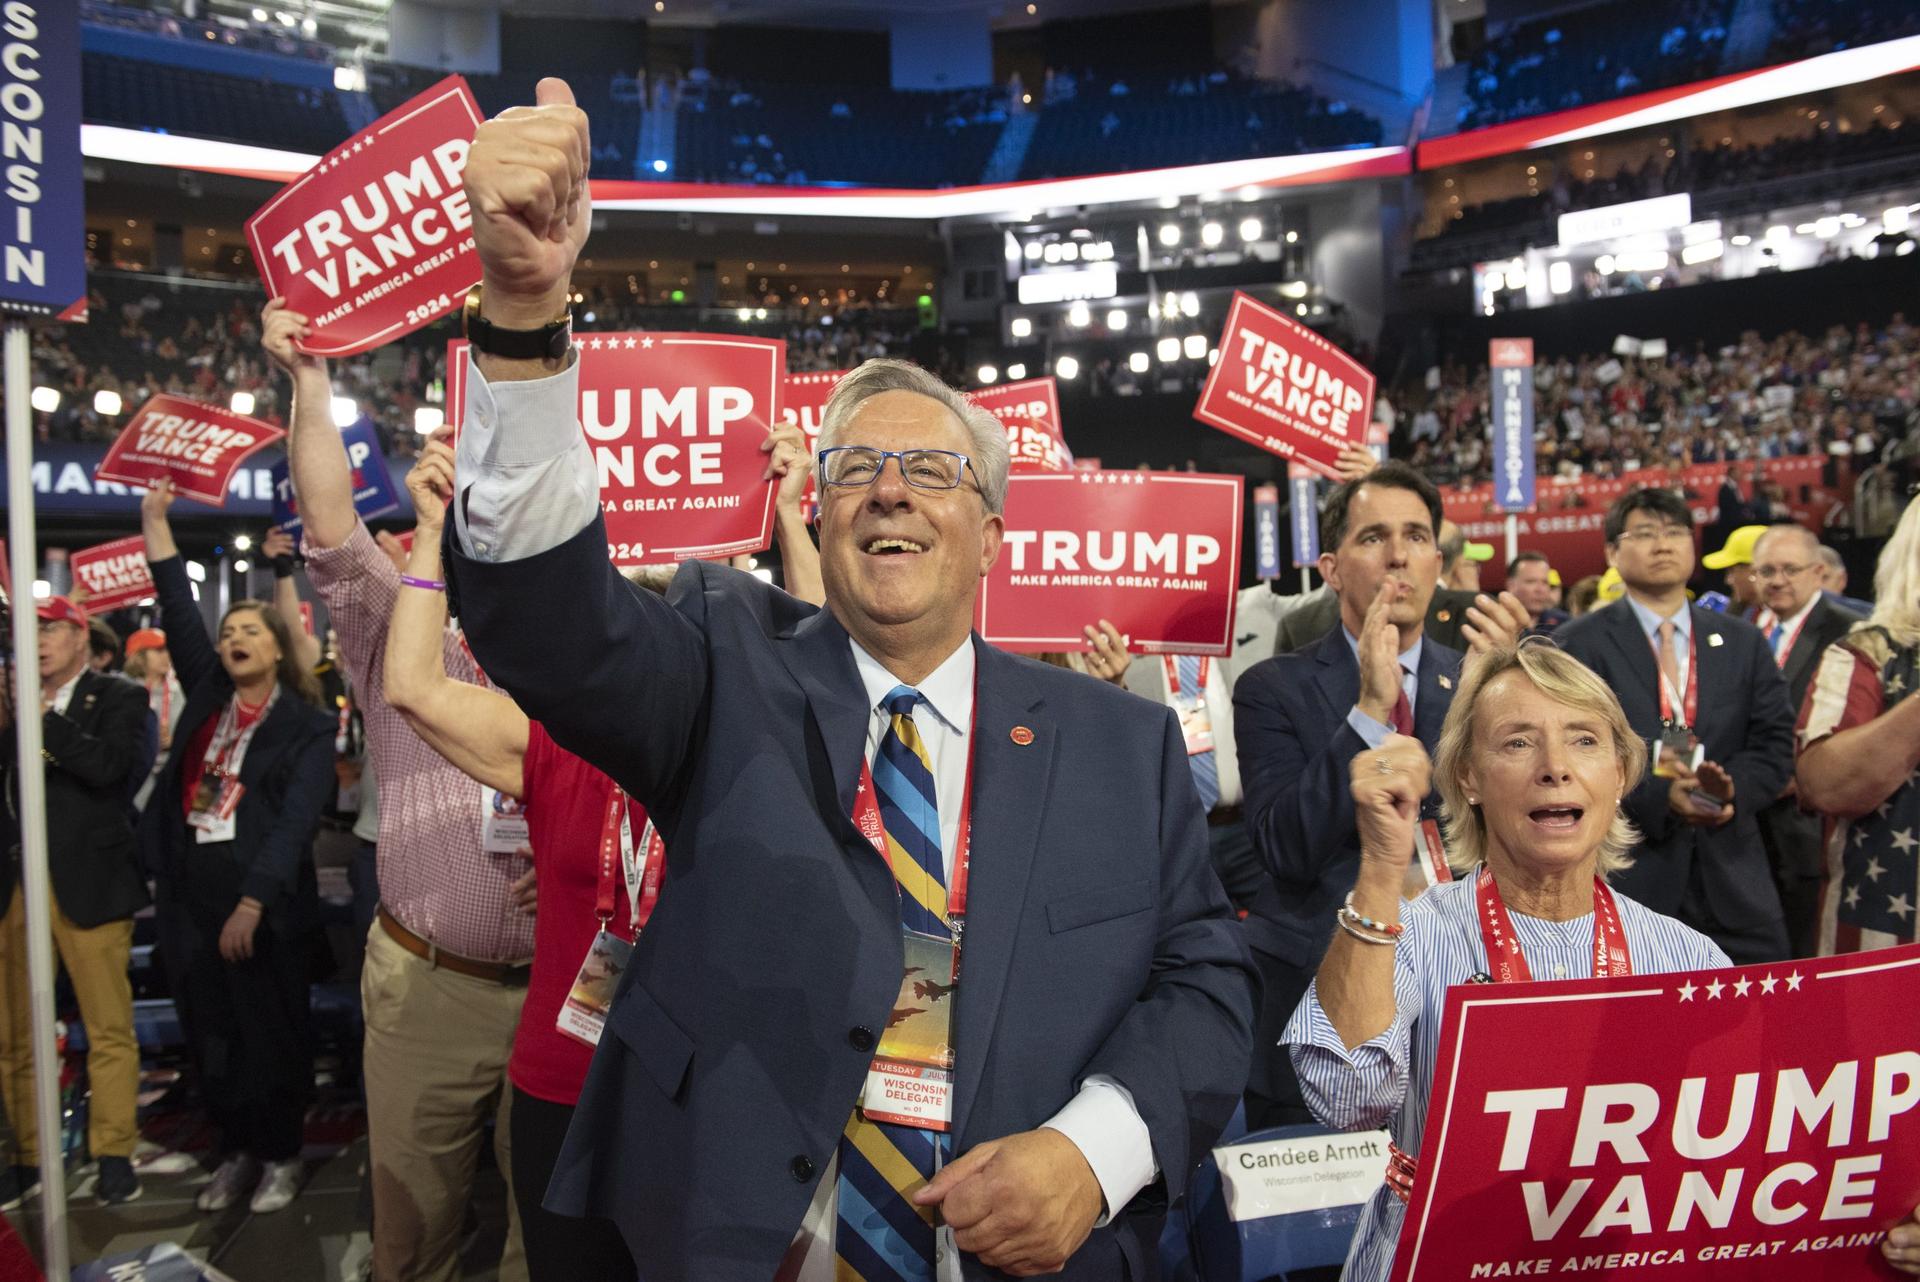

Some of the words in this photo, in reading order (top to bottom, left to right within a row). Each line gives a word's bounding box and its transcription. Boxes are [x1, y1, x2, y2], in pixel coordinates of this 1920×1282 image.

[272, 138, 471, 274] TRUMP
[304, 190, 473, 298] VANCE
[316, 303, 353, 327] MAKE
[355, 273, 413, 308] AMERICA
[414, 248, 455, 276] GREAT
[406, 294, 451, 324] 2024
[1239, 327, 1363, 413] TRUMP
[1246, 365, 1349, 436] VANCE
[141, 411, 255, 449] TRUMP
[1503, 368, 1523, 502] MINNESOTA
[135, 433, 225, 465] VANCE
[623, 498, 676, 512] GREAT
[683, 495, 740, 510] AGAIN!
[1003, 530, 1220, 575] TRUMP
[1010, 575, 1047, 587] MAKE
[1052, 575, 1112, 587] AMERICA
[1116, 576, 1159, 589] GREAT
[1163, 578, 1208, 591] AGAIN!
[860, 814, 871, 838] DATA
[866, 807, 881, 836] TRUST
[875, 1062, 916, 1075] TUESDAY
[928, 1071, 946, 1080] JULY
[884, 1078, 948, 1096] WISCONSIN
[885, 1089, 943, 1106] DELEGATE
[1484, 1051, 1920, 1171] TRUMP
[1240, 1147, 1320, 1170] Candee
[1325, 1141, 1381, 1162] Arndt
[1263, 1174, 1313, 1187] Wisconsin
[1314, 1169, 1365, 1184] Delegation
[1521, 1154, 1882, 1242] VANCE
[1470, 1258, 1561, 1280] MAKE
[1561, 1249, 1686, 1273] AMERICA
[1697, 1240, 1786, 1262] GREAT
